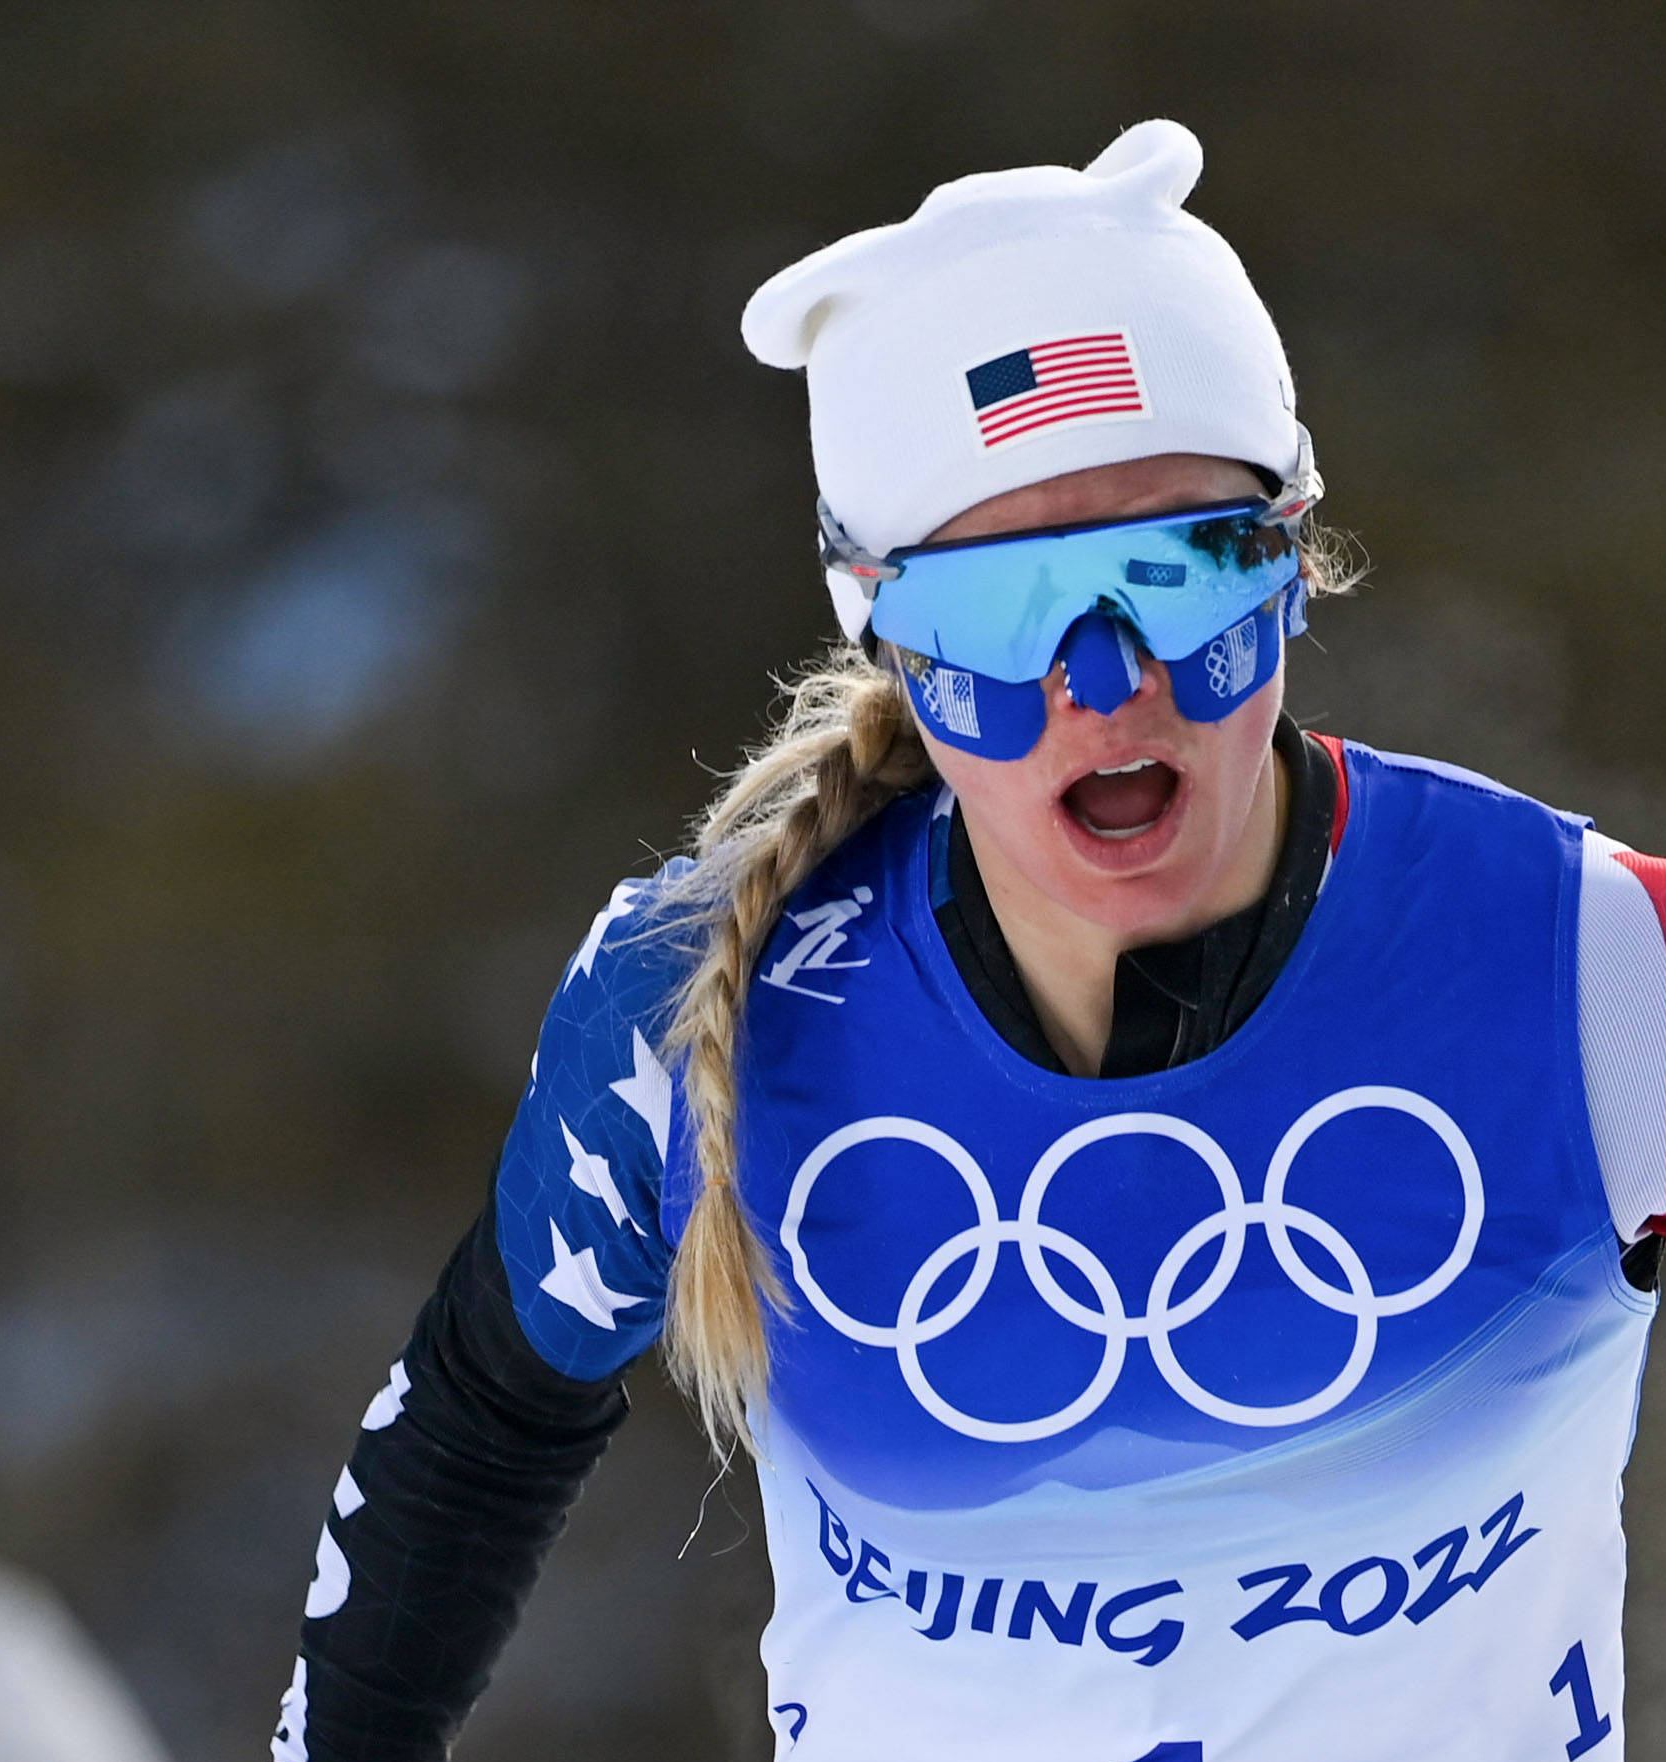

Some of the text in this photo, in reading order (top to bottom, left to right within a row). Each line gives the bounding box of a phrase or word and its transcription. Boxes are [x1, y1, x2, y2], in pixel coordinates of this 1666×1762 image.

[805, 1476, 1542, 1668] BEIJING 2022
[1548, 1639, 1613, 1762] 1
